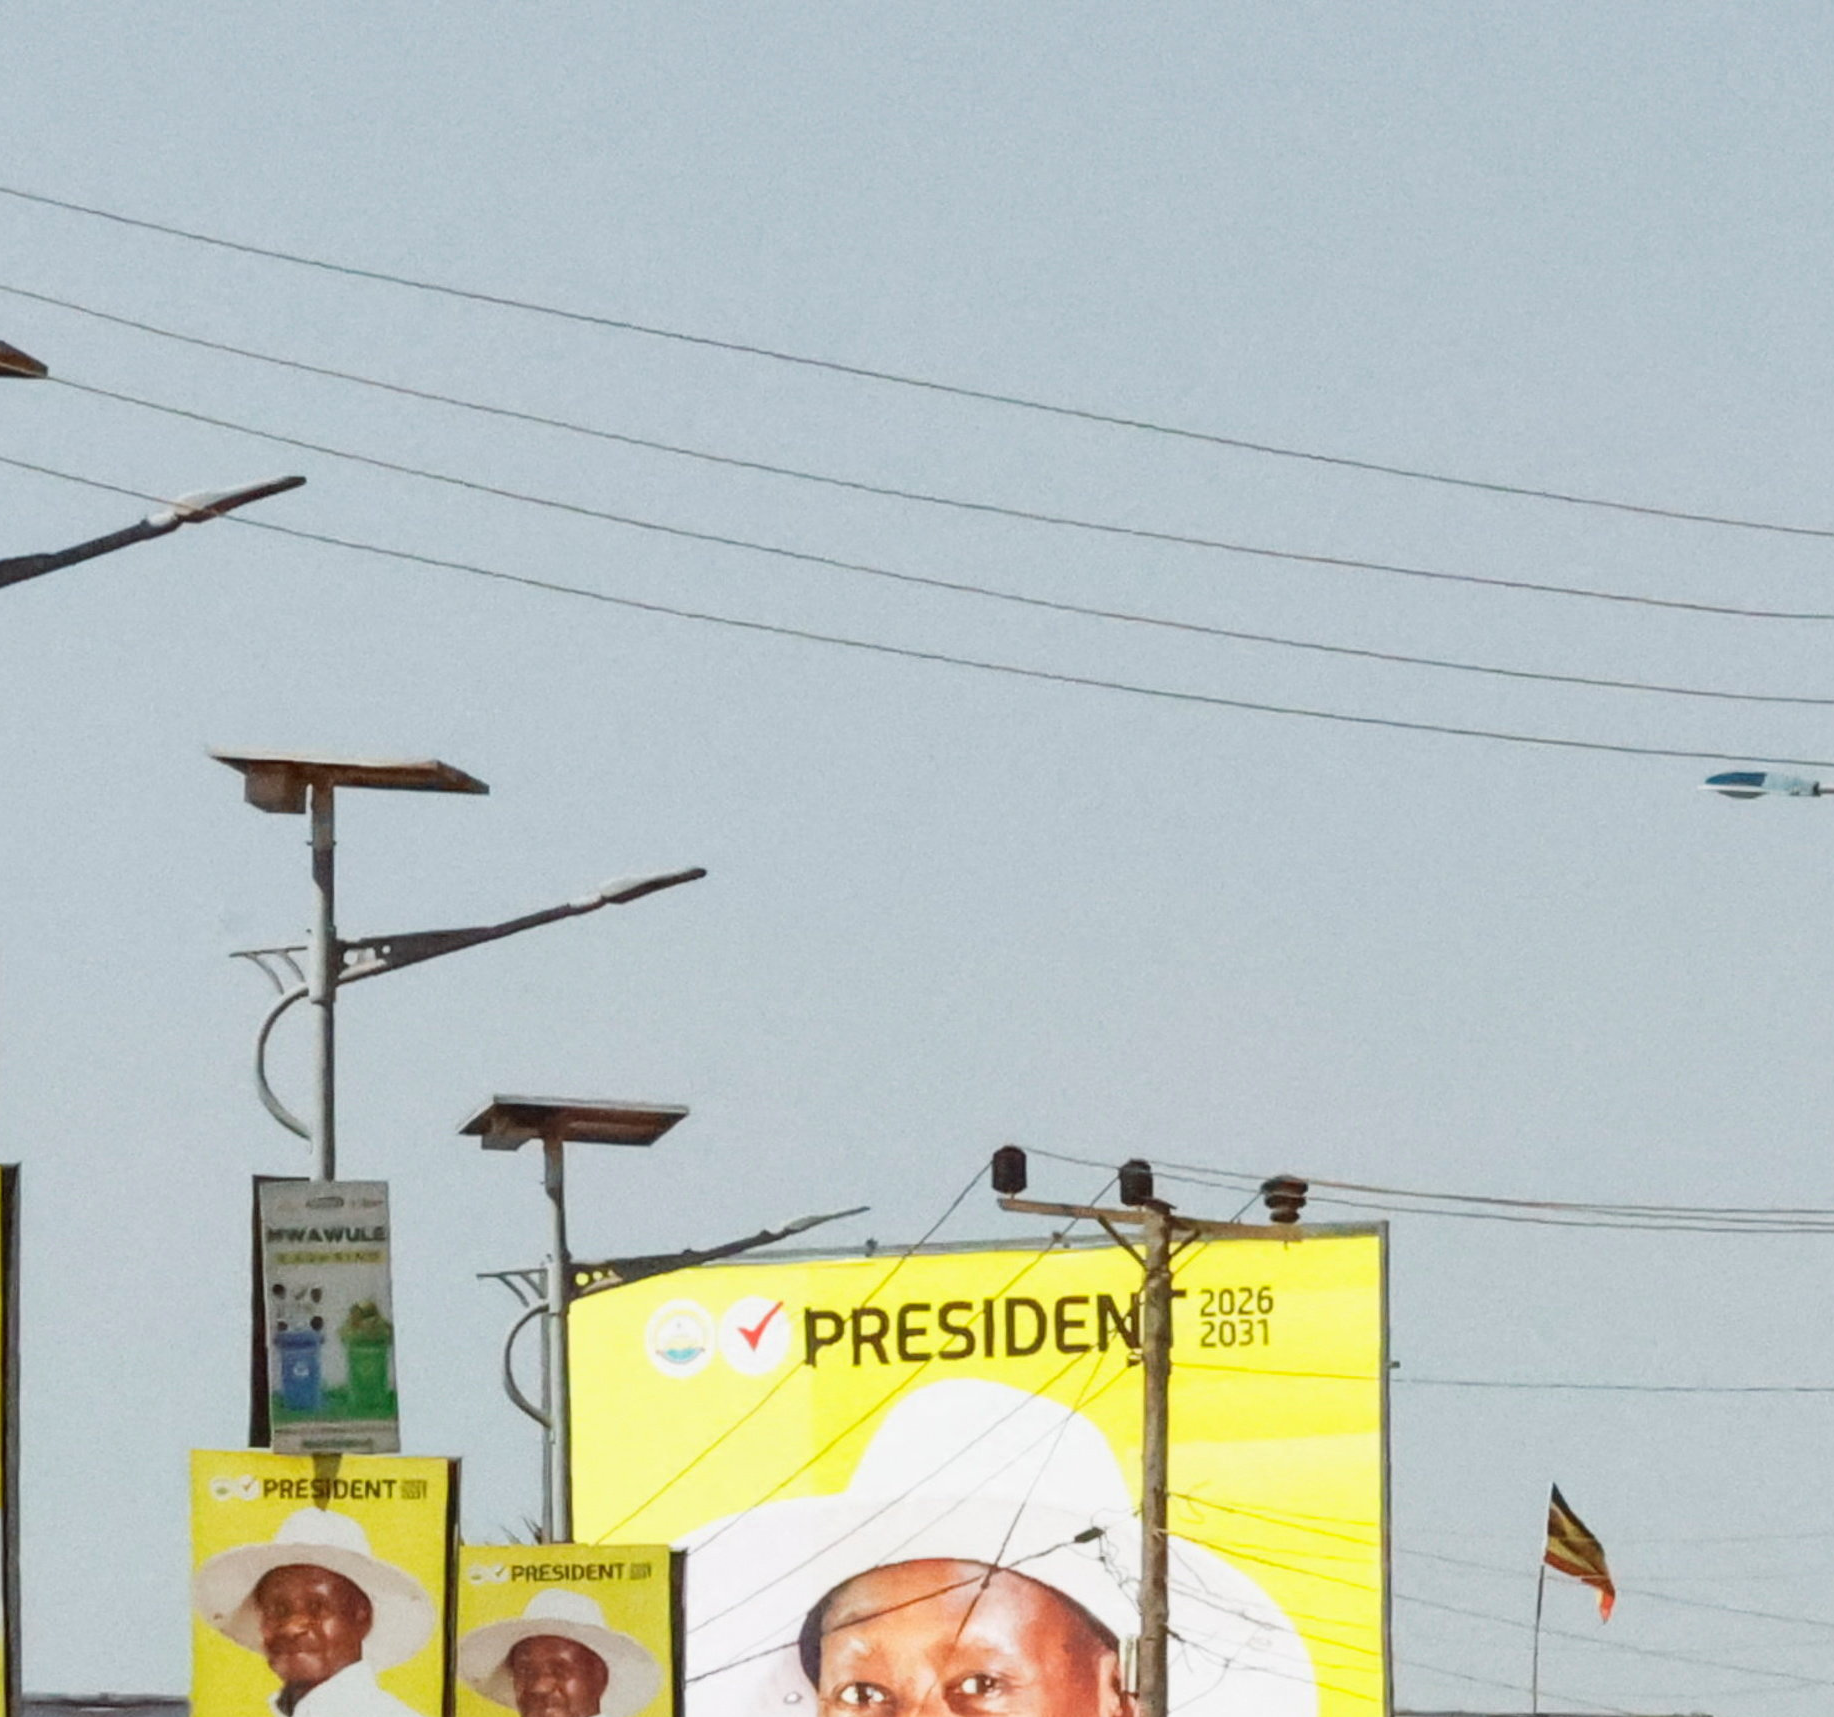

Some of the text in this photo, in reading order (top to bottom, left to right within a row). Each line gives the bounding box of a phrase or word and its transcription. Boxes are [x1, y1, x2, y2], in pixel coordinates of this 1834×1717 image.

[1199, 1287, 1274, 1317] 2026
[1200, 1319, 1271, 1348] 2031
[263, 1478, 398, 1500] PRESIDENT
[511, 1562, 625, 1582] PRESIDENT
